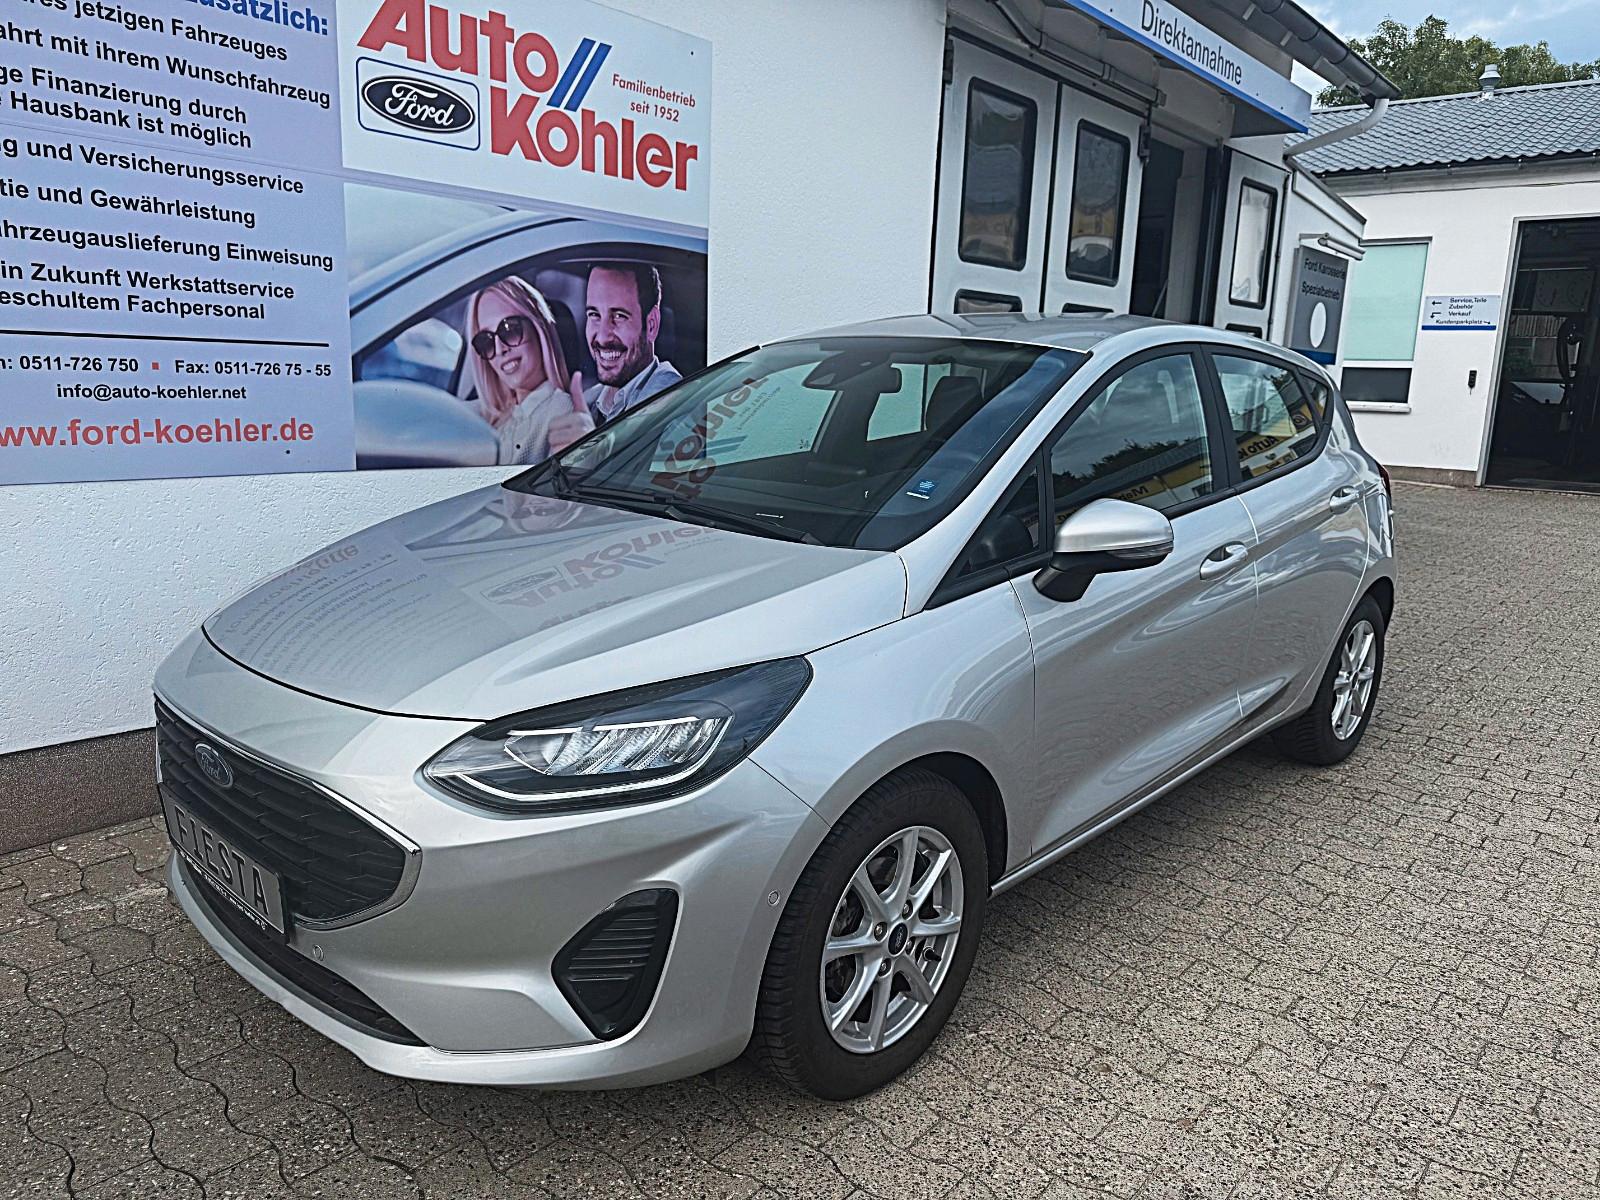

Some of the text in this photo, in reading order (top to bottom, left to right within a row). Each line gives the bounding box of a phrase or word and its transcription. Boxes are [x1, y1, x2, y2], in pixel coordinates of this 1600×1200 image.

[74, 0, 289, 61] jetzigen Fahrzeuges
[357, 0, 560, 93] Auto
[1141, 0, 1242, 86] Direktannahme
[51, 35, 89, 57] mit
[96, 41, 160, 71] ihrem
[166, 55, 331, 109] Wunschfahrzeug
[612, 73, 696, 109] Familienbetrieb
[32, 67, 182, 116] Finanzierung
[188, 99, 247, 124] durch
[385, 82, 456, 127] Ford
[630, 100, 680, 123] seit 1952
[10, 90, 131, 129] Hausbank
[137, 113, 165, 134] ist
[170, 122, 251, 148] möglich
[27, 141, 73, 162] und
[79, 145, 304, 194] Versicherungsservice
[38, 186, 83, 205] und
[90, 189, 256, 229] Gewährleistung
[0, 220, 334, 271] hrzeugauslieferung Einweisung
[1304, 257, 1318, 272] Ford
[31, 262, 122, 287] Zukunft
[127, 270, 295, 299] Werkstattservice
[127, 295, 266, 319] Fachpersonal
[19, 356, 103, 371] 0511-726
[108, 358, 139, 372] 750
[175, 360, 209, 375] Fax:
[214, 361, 282, 376] 0511-726
[285, 364, 302, 376] 75
[315, 364, 332, 377] 55
[57, 384, 247, 401] info@auto-koehler.net
[201, 751, 221, 779] Ford
[174, 804, 270, 916] FIESTA
